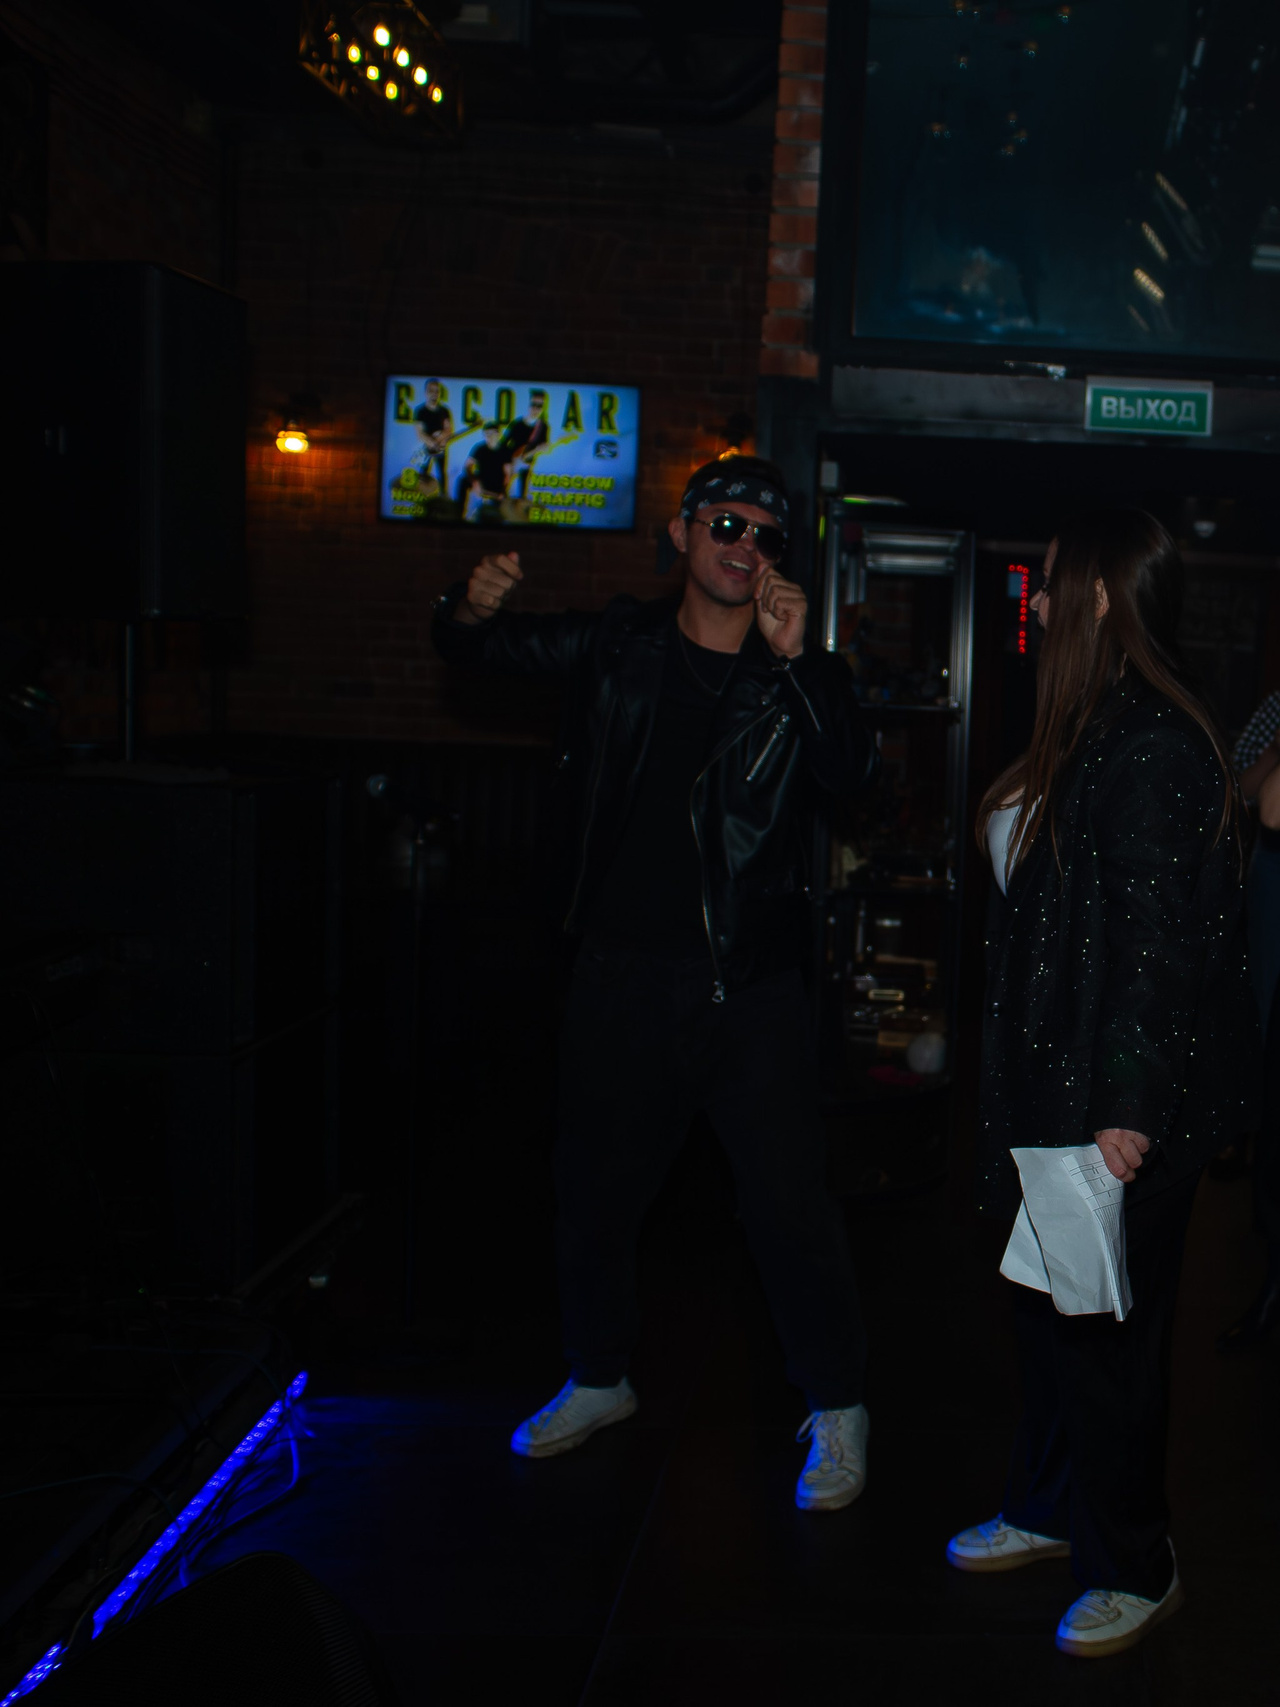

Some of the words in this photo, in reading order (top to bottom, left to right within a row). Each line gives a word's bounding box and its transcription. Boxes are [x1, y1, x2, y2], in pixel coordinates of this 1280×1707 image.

[1101, 396, 1197, 425] ВЫХОД
[531, 473, 615, 491] MOSCOW
[531, 491, 606, 509] TRAFFIC
[529, 507, 581, 524] BAND
